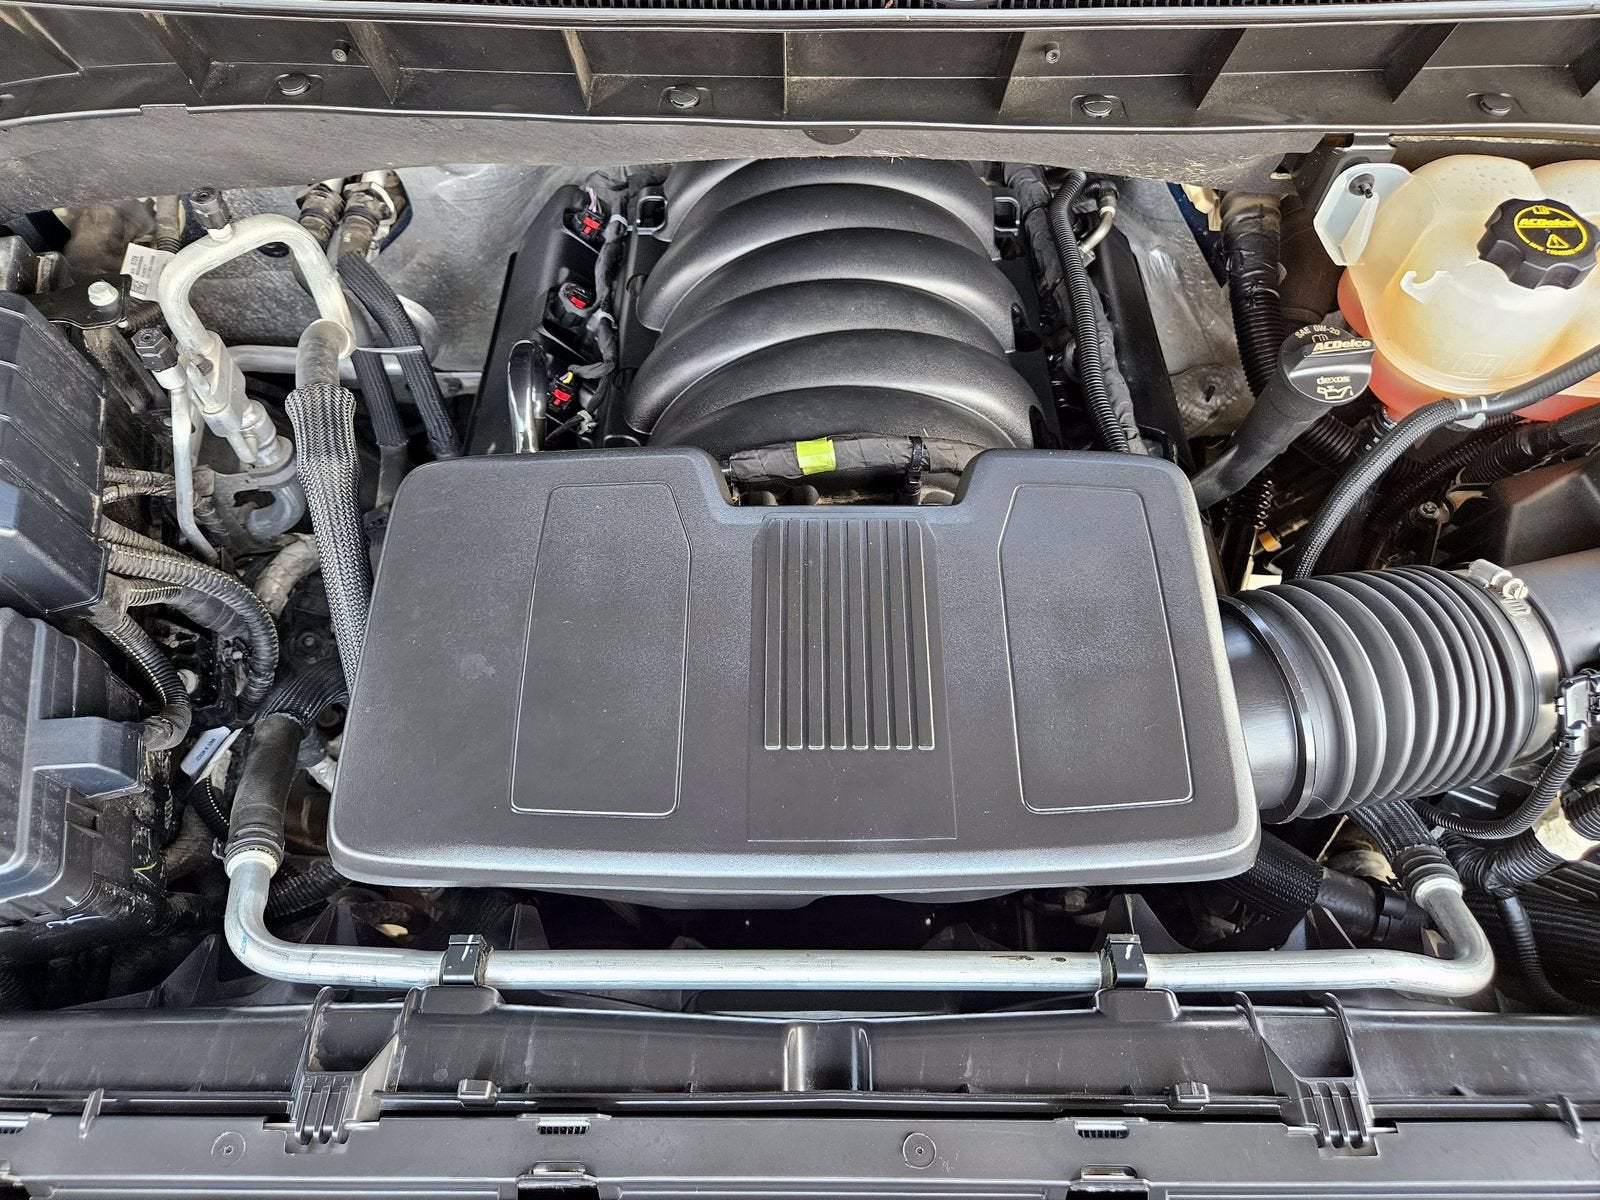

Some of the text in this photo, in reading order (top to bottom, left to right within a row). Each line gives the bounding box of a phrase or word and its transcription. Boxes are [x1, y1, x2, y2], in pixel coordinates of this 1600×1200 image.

[1294, 324, 1341, 339] SAE 0W-20
[1312, 339, 1371, 352] ACDelco
[1316, 376, 1351, 385] dexos
